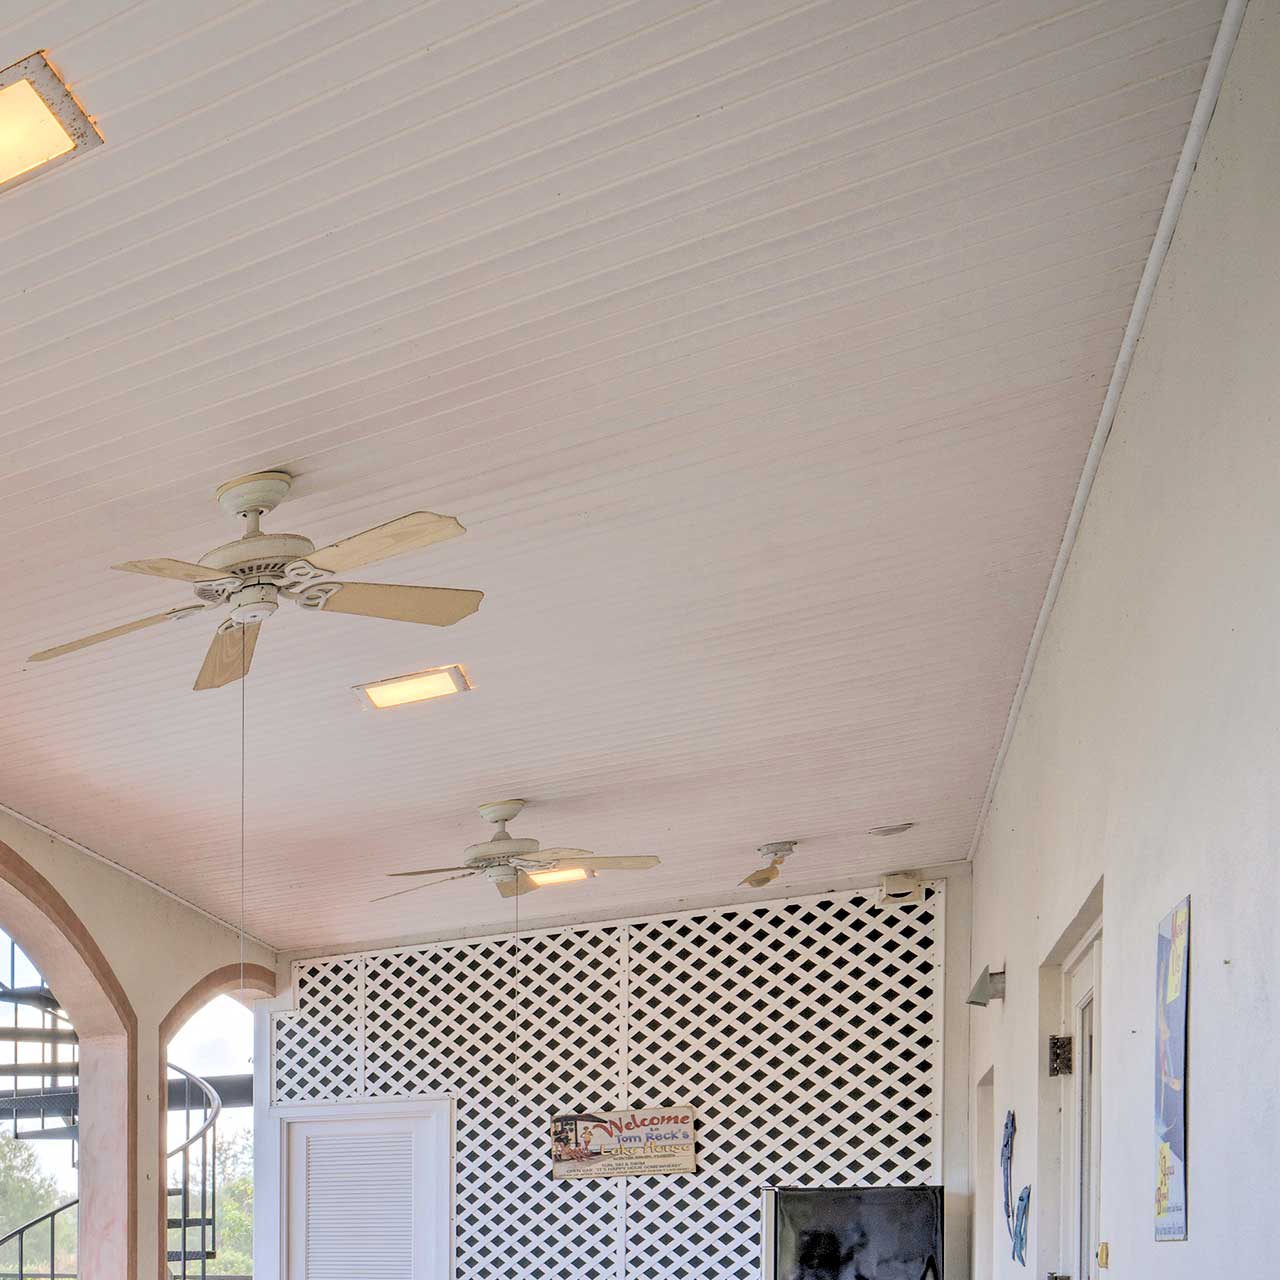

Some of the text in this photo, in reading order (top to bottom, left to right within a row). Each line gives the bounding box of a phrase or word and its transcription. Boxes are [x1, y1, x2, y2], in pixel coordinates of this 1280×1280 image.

[592, 1114, 690, 1138] Welcome
[614, 1128, 690, 1144] Tom Reck's
[600, 1142, 690, 1156] Lake House
